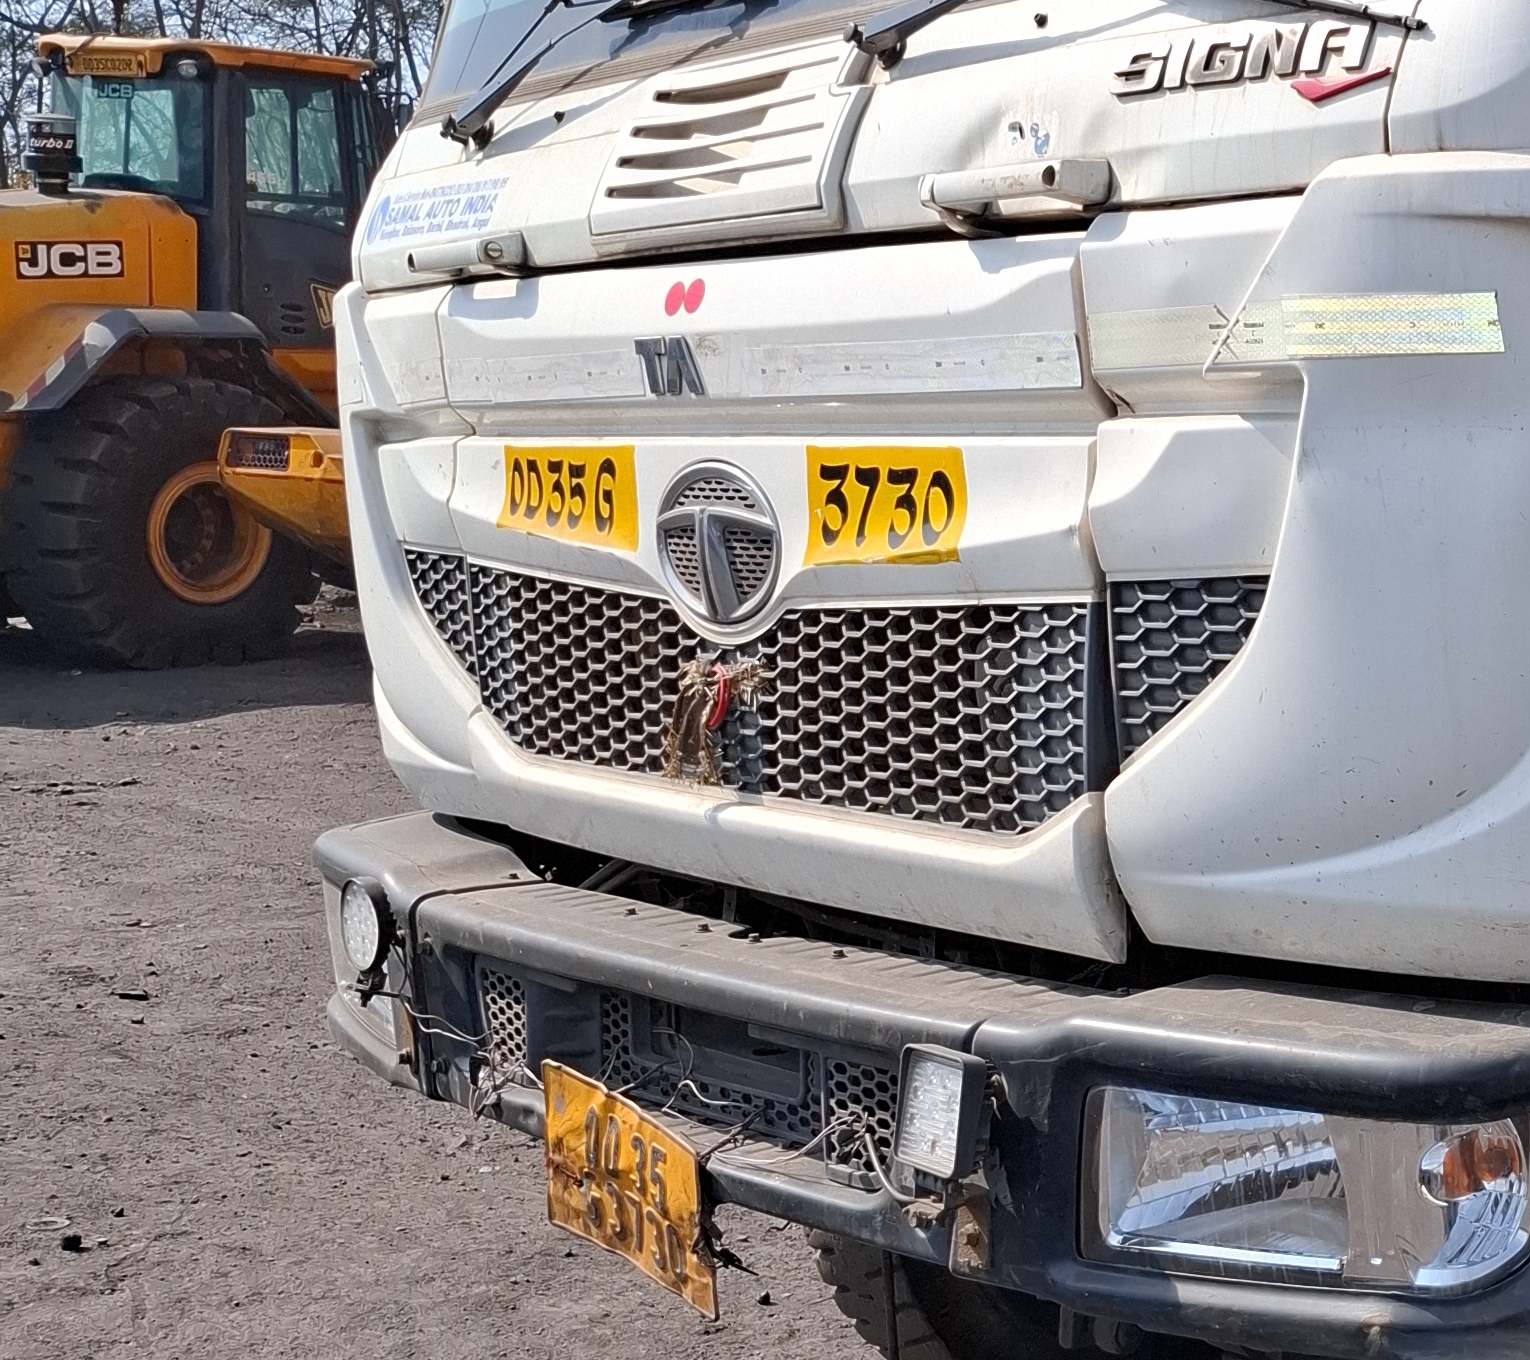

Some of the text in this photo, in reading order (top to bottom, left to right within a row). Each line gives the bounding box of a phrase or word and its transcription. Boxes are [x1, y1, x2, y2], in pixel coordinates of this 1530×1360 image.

[1109, 19, 1376, 97] SIGNA
[99, 84, 133, 98] JCB
[30, 138, 62, 149] turbo
[384, 192, 499, 227] SAMAL AUTO INDIA
[19, 243, 122, 277] JCB
[633, 335, 706, 396] TA
[818, 462, 956, 550] 3730
